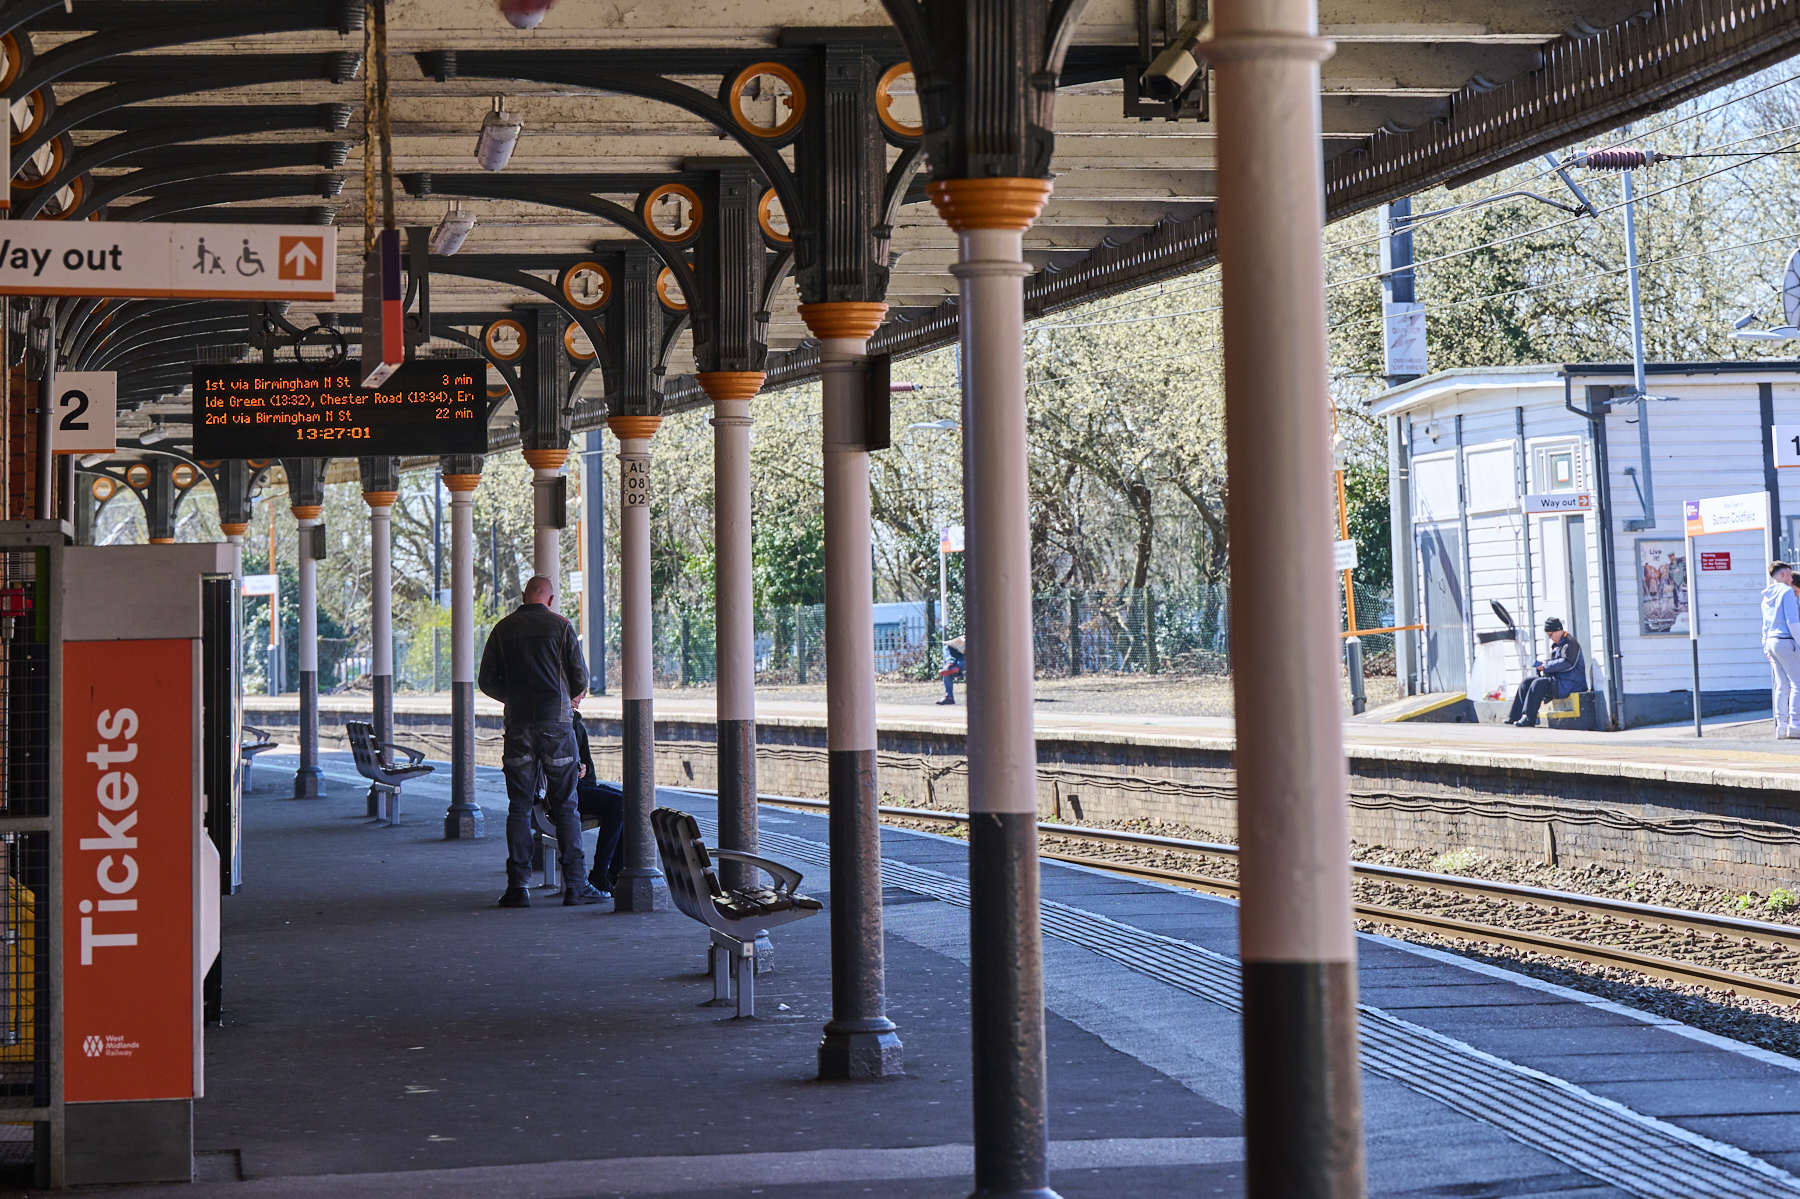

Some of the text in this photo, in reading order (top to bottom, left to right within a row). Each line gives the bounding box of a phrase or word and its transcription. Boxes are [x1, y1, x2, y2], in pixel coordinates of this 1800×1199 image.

[62, 244, 122, 271] out
[205, 375, 473, 391] 1st via Birmingham N St 3 min
[229, 396, 265, 407] Green
[270, 394, 315, 408] (13:32),
[320, 394, 369, 405] Chester
[374, 392, 402, 403] Road
[407, 391, 453, 404] (13:34),
[59, 389, 89, 431] 2
[205, 408, 473, 425] 2nd via Birmingham N St 22 min
[296, 427, 371, 439] 13:27:01
[1791, 436, 1800, 456] 1
[631, 463, 645, 473] AL
[629, 478, 645, 489] 08
[629, 494, 645, 504] 02
[1541, 498, 1560, 508] Way
[1713, 510, 1755, 525] Sutton Coldfield
[78, 707, 139, 965] Tickets
[105, 1041, 140, 1049] Midlands
[105, 1049, 133, 1057] Railway
